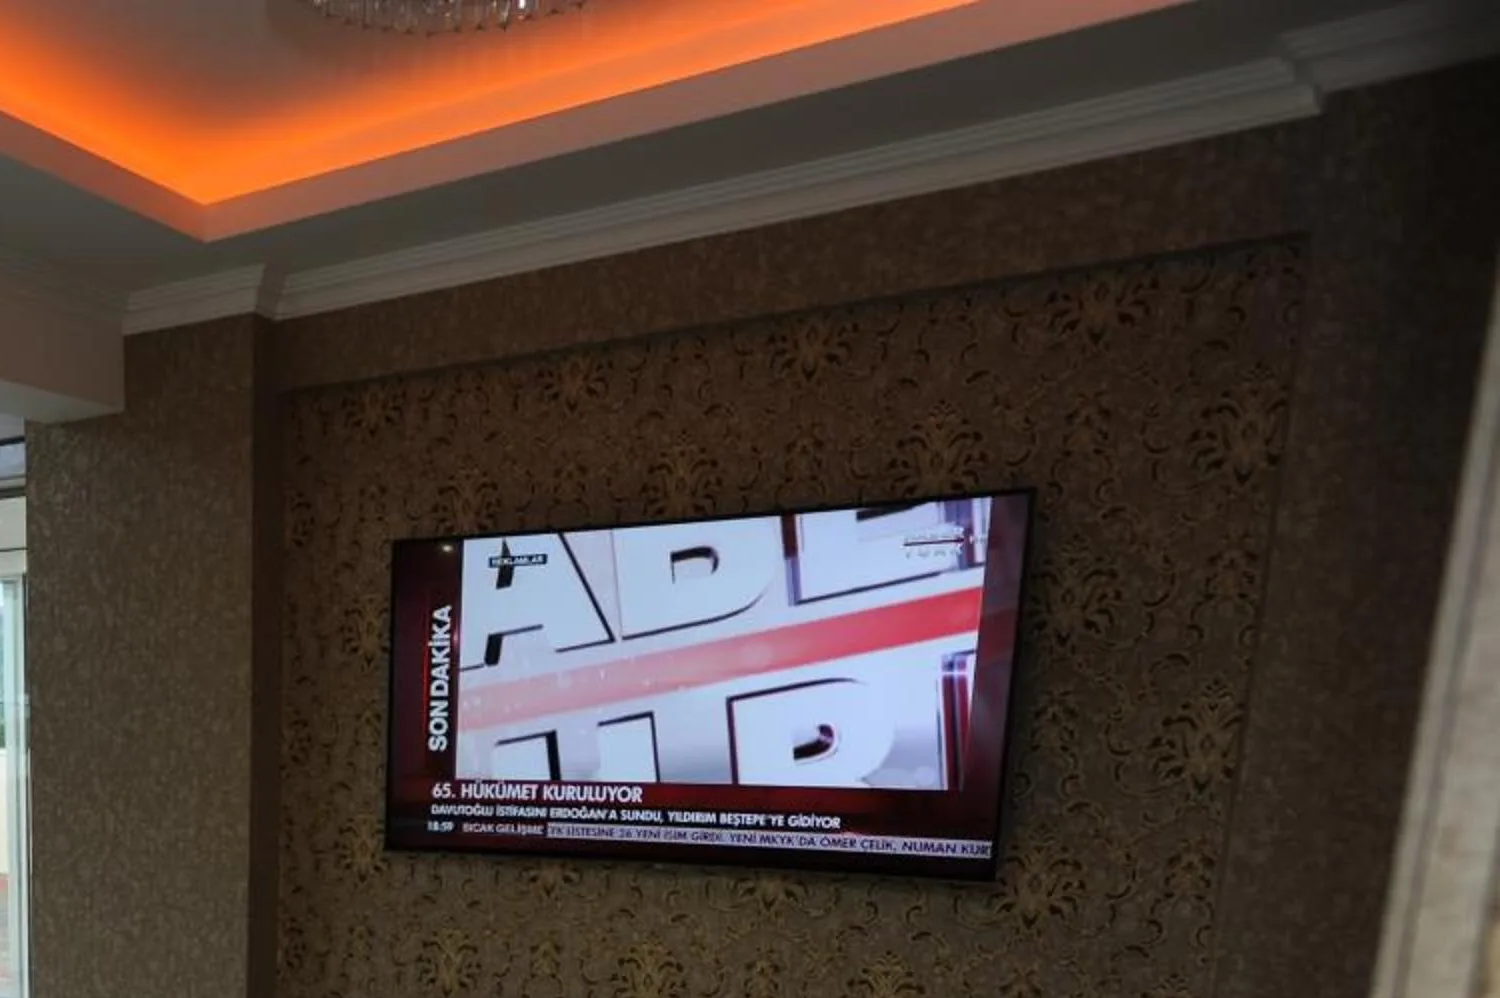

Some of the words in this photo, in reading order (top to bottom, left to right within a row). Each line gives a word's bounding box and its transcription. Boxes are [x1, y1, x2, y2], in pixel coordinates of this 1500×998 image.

[427, 605, 452, 697] DAKİKA
[428, 700, 448, 752] SON
[432, 783, 455, 800] 65.
[461, 780, 538, 801] HÜKÜMET
[542, 784, 643, 803] KURULUYOR
[667, 811, 716, 824] YILDIRIM
[788, 813, 841, 829] GİDİYOR
[902, 841, 957, 854] NUMAN
